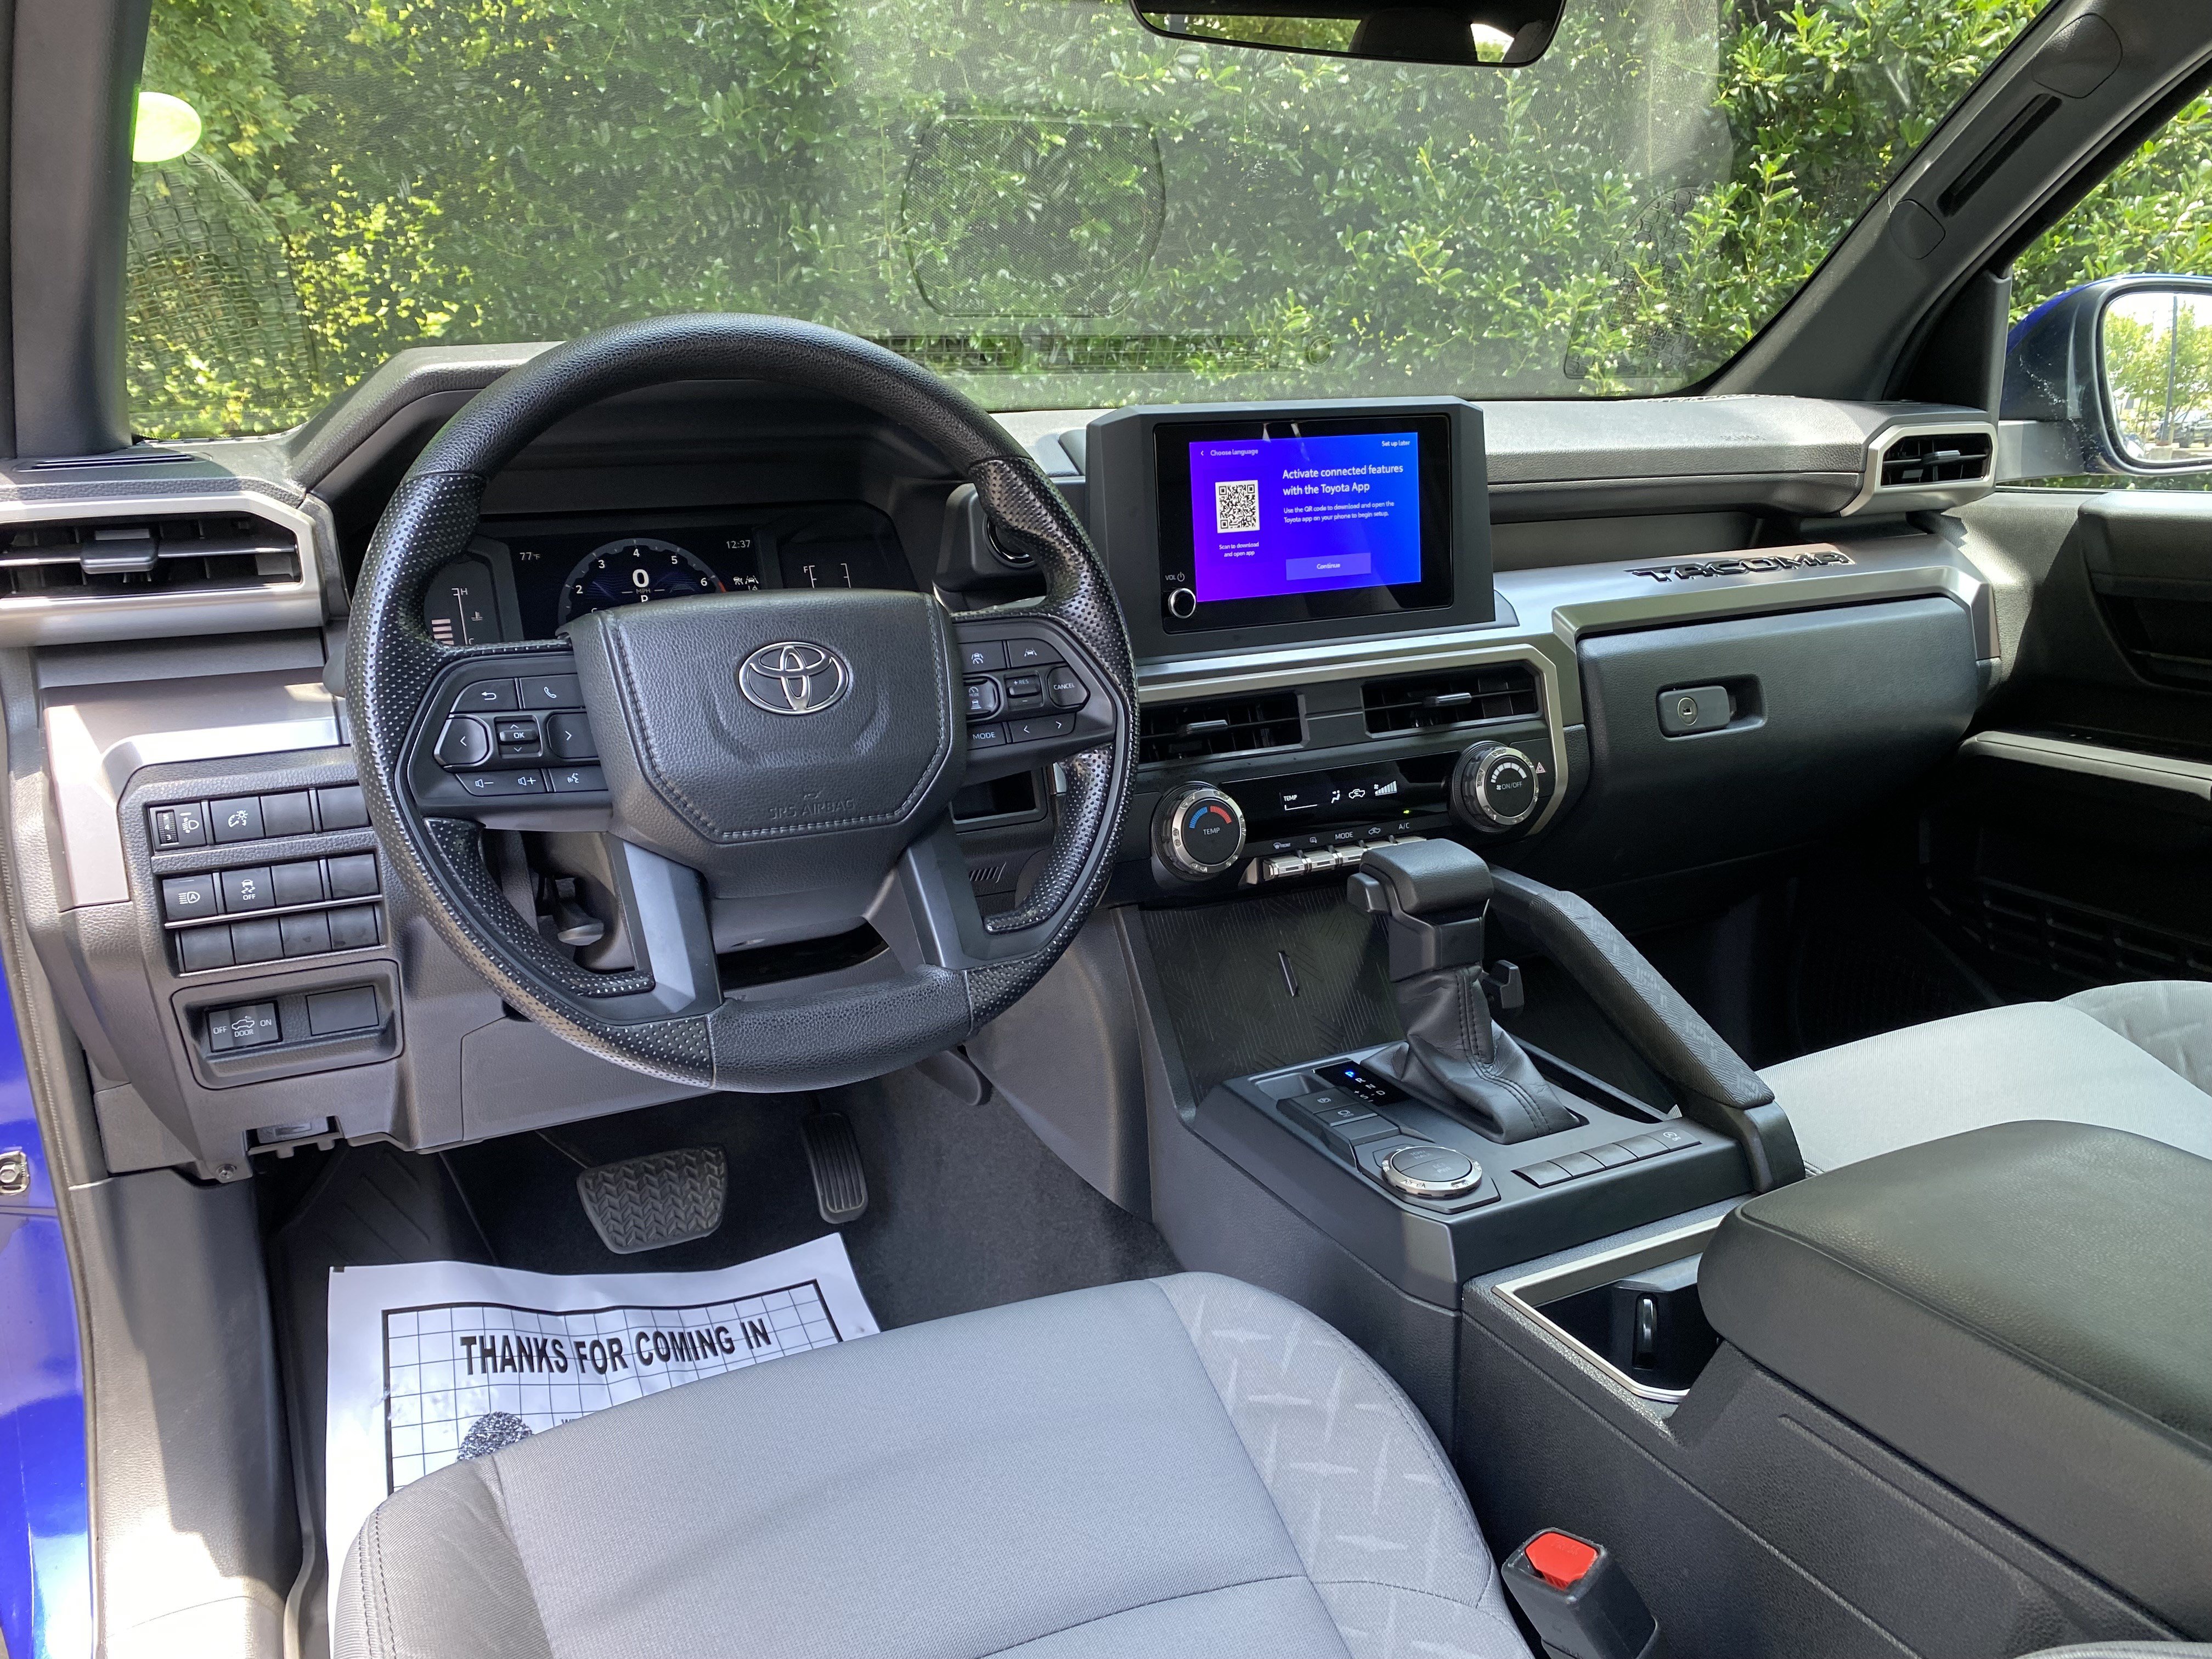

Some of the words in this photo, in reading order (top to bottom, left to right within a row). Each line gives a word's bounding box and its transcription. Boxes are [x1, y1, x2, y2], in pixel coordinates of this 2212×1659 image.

[1282, 468, 1319, 479] Activate
[1321, 465, 1367, 477] connected
[1368, 464, 1403, 475] features
[1283, 485, 1303, 496] with
[1304, 484, 1319, 494] the
[1321, 482, 1350, 495] Toyota
[1352, 482, 1370, 493] App
[1284, 516, 1301, 524] Toyota
[1358, 512, 1373, 520] begin
[726, 540, 751, 549] 12:37
[633, 549, 640, 557] 4
[599, 560, 605, 568] 3
[671, 555, 678, 565] 5
[1623, 549, 1857, 583] TACOMA
[632, 569, 650, 588] 0
[700, 578, 708, 586] 6
[575, 585, 583, 594] 2
[641, 595, 648, 603] P
[972, 731, 996, 740] MODE
[1502, 781, 1522, 789] ON/OFF
[802, 798, 855, 816] AIRBAG
[1203, 827, 1220, 836] TEMP
[1335, 831, 1353, 840] MODE
[259, 1019, 272, 1027] ON
[213, 1026, 227, 1034] OFF
[234, 1029, 254, 1037] DOOR
[460, 1334, 568, 1375] THANKS
[573, 1336, 628, 1375] FOR
[635, 1325, 734, 1365] COMING
[739, 1318, 772, 1350] IN
